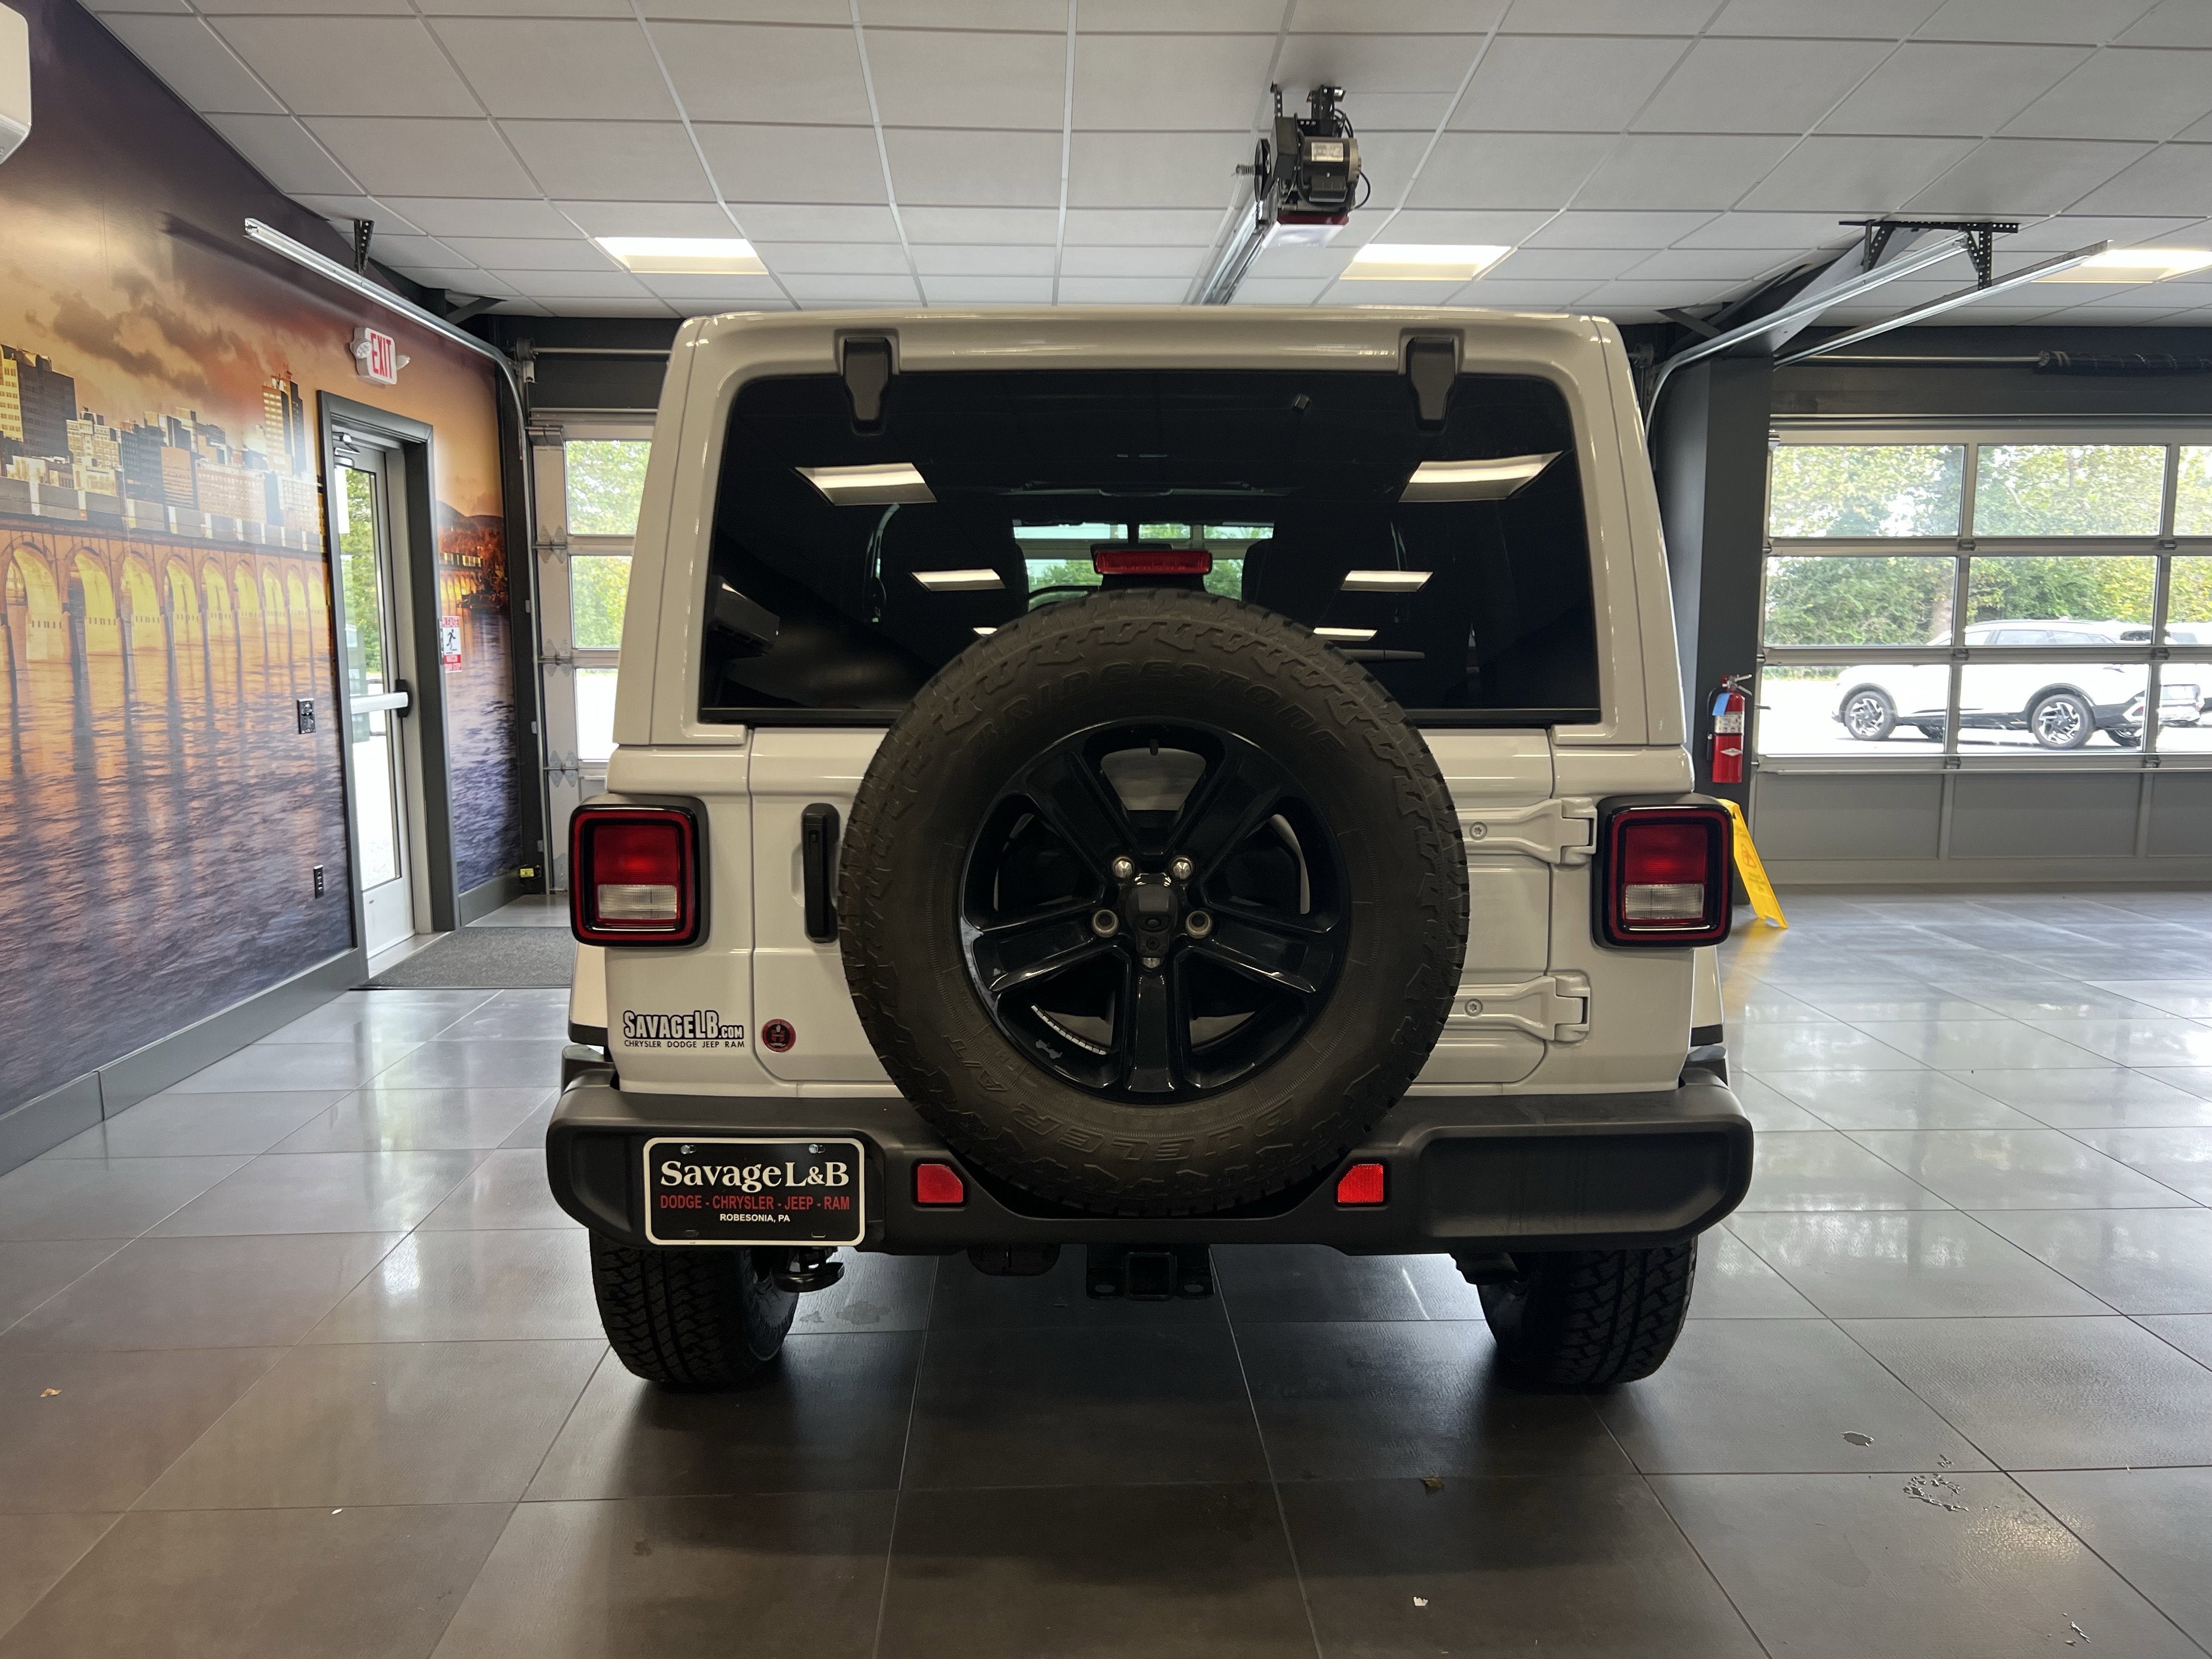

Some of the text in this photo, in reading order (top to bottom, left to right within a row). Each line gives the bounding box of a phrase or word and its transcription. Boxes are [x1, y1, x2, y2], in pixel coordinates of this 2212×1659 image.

[371, 333, 392, 379] EXIT
[624, 1040, 662, 1048] CHRYSLER
[660, 1195, 702, 1209] DODGE
[713, 1195, 775, 1210] CHRYSLER
[785, 1196, 814, 1210] JEEP
[824, 1196, 850, 1210] RAM
[720, 1214, 791, 1223] ROBESONIA, PA
